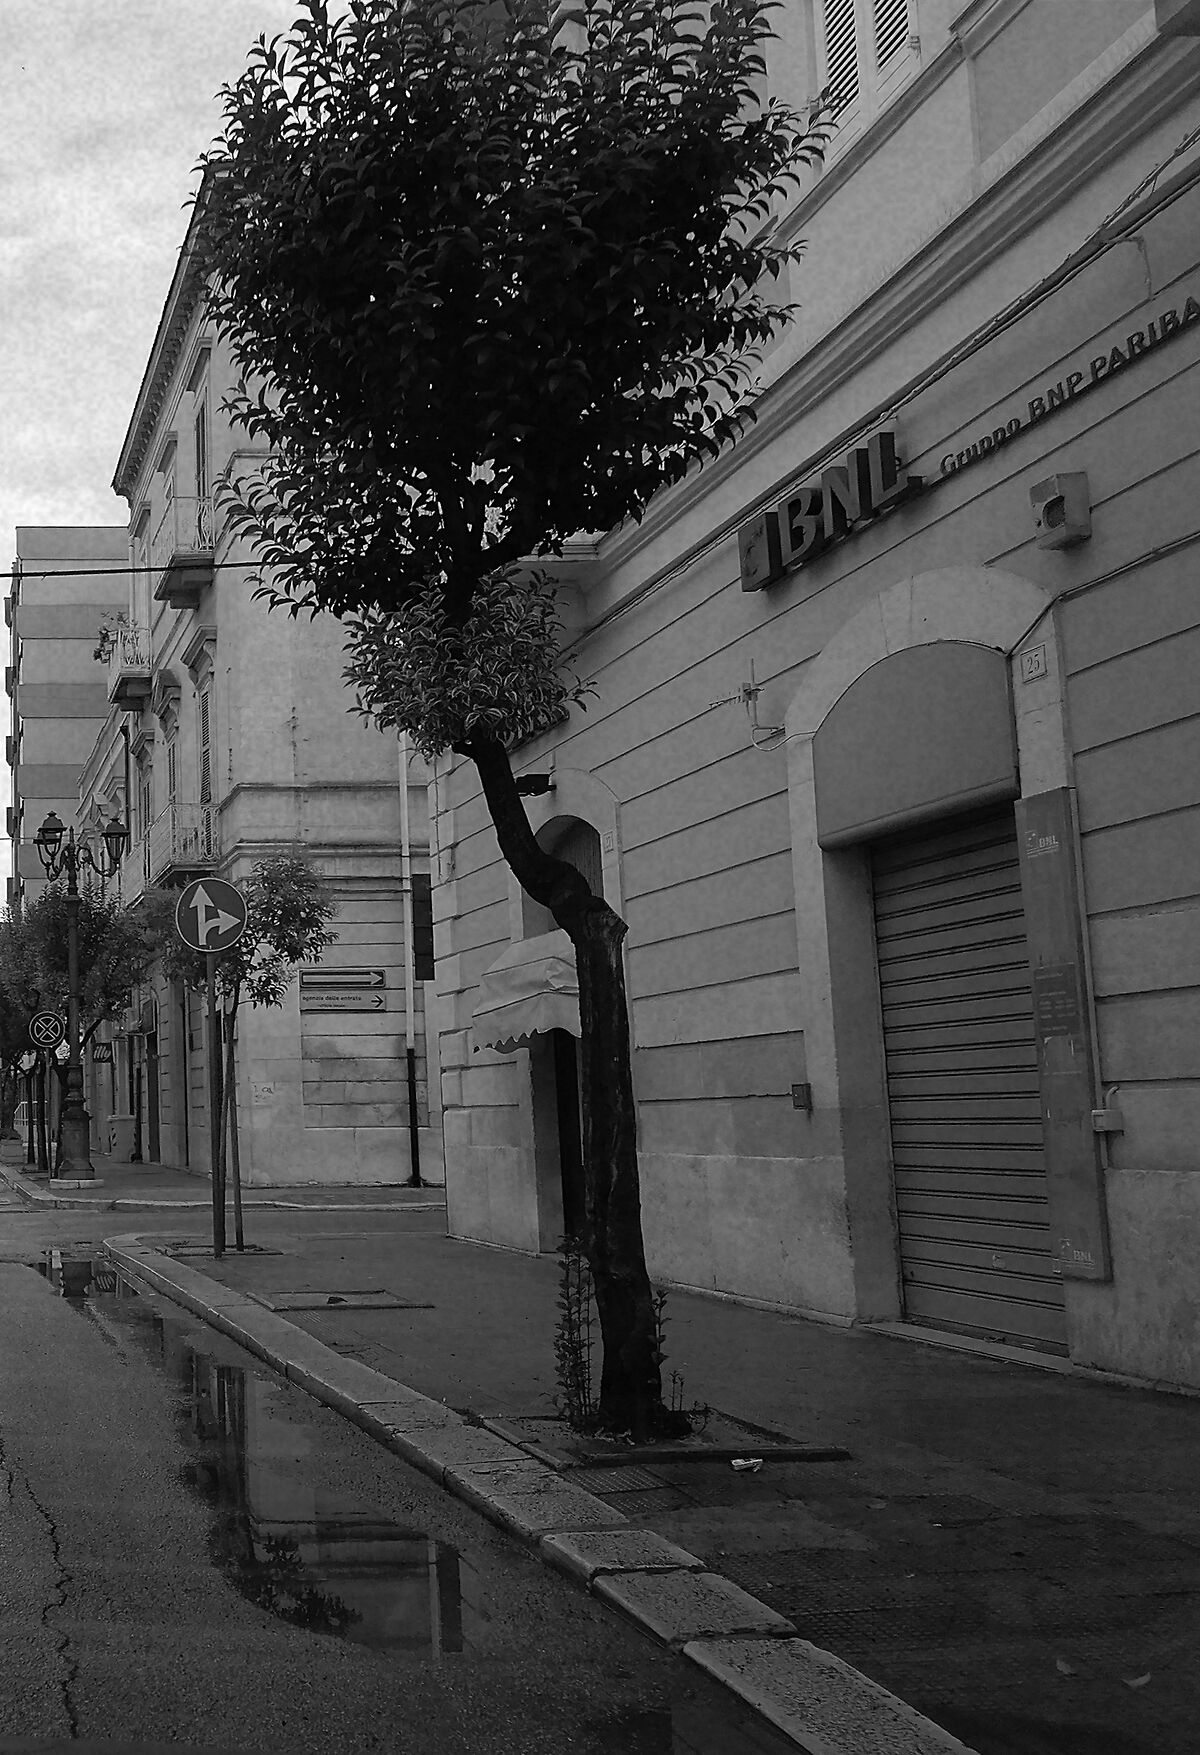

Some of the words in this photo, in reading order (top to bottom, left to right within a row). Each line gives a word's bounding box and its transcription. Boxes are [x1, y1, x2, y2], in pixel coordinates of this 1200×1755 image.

[939, 417, 1021, 477] Gruppo
[1027, 371, 1083, 422] BNP
[778, 432, 924, 568] BNL
[1027, 653, 1040, 674] 25
[93, 1045, 112, 1062] illy
